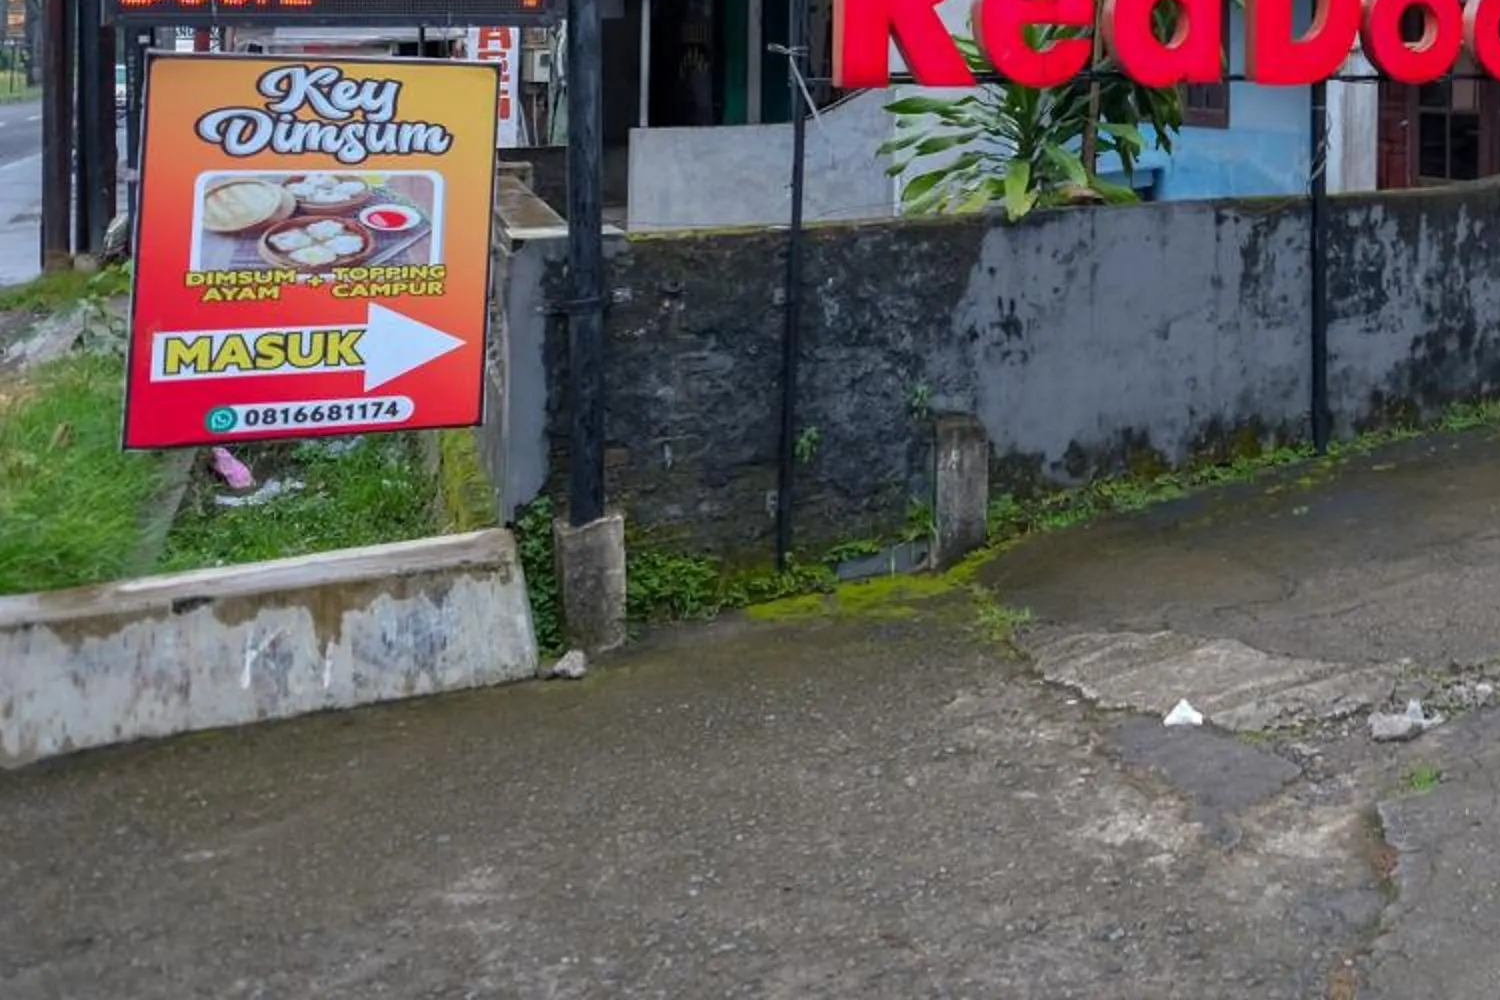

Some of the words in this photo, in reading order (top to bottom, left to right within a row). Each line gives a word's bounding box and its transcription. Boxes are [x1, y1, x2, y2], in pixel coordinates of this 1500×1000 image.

[256, 64, 403, 123] Key
[194, 105, 454, 164] Dimsum
[185, 268, 297, 287] DIMSUM
[331, 264, 447, 282] TOPPING
[202, 285, 281, 302] AYAM
[331, 280, 446, 298] CAMPUR
[162, 328, 368, 375] MASUK
[244, 401, 400, 427] 0816681174
